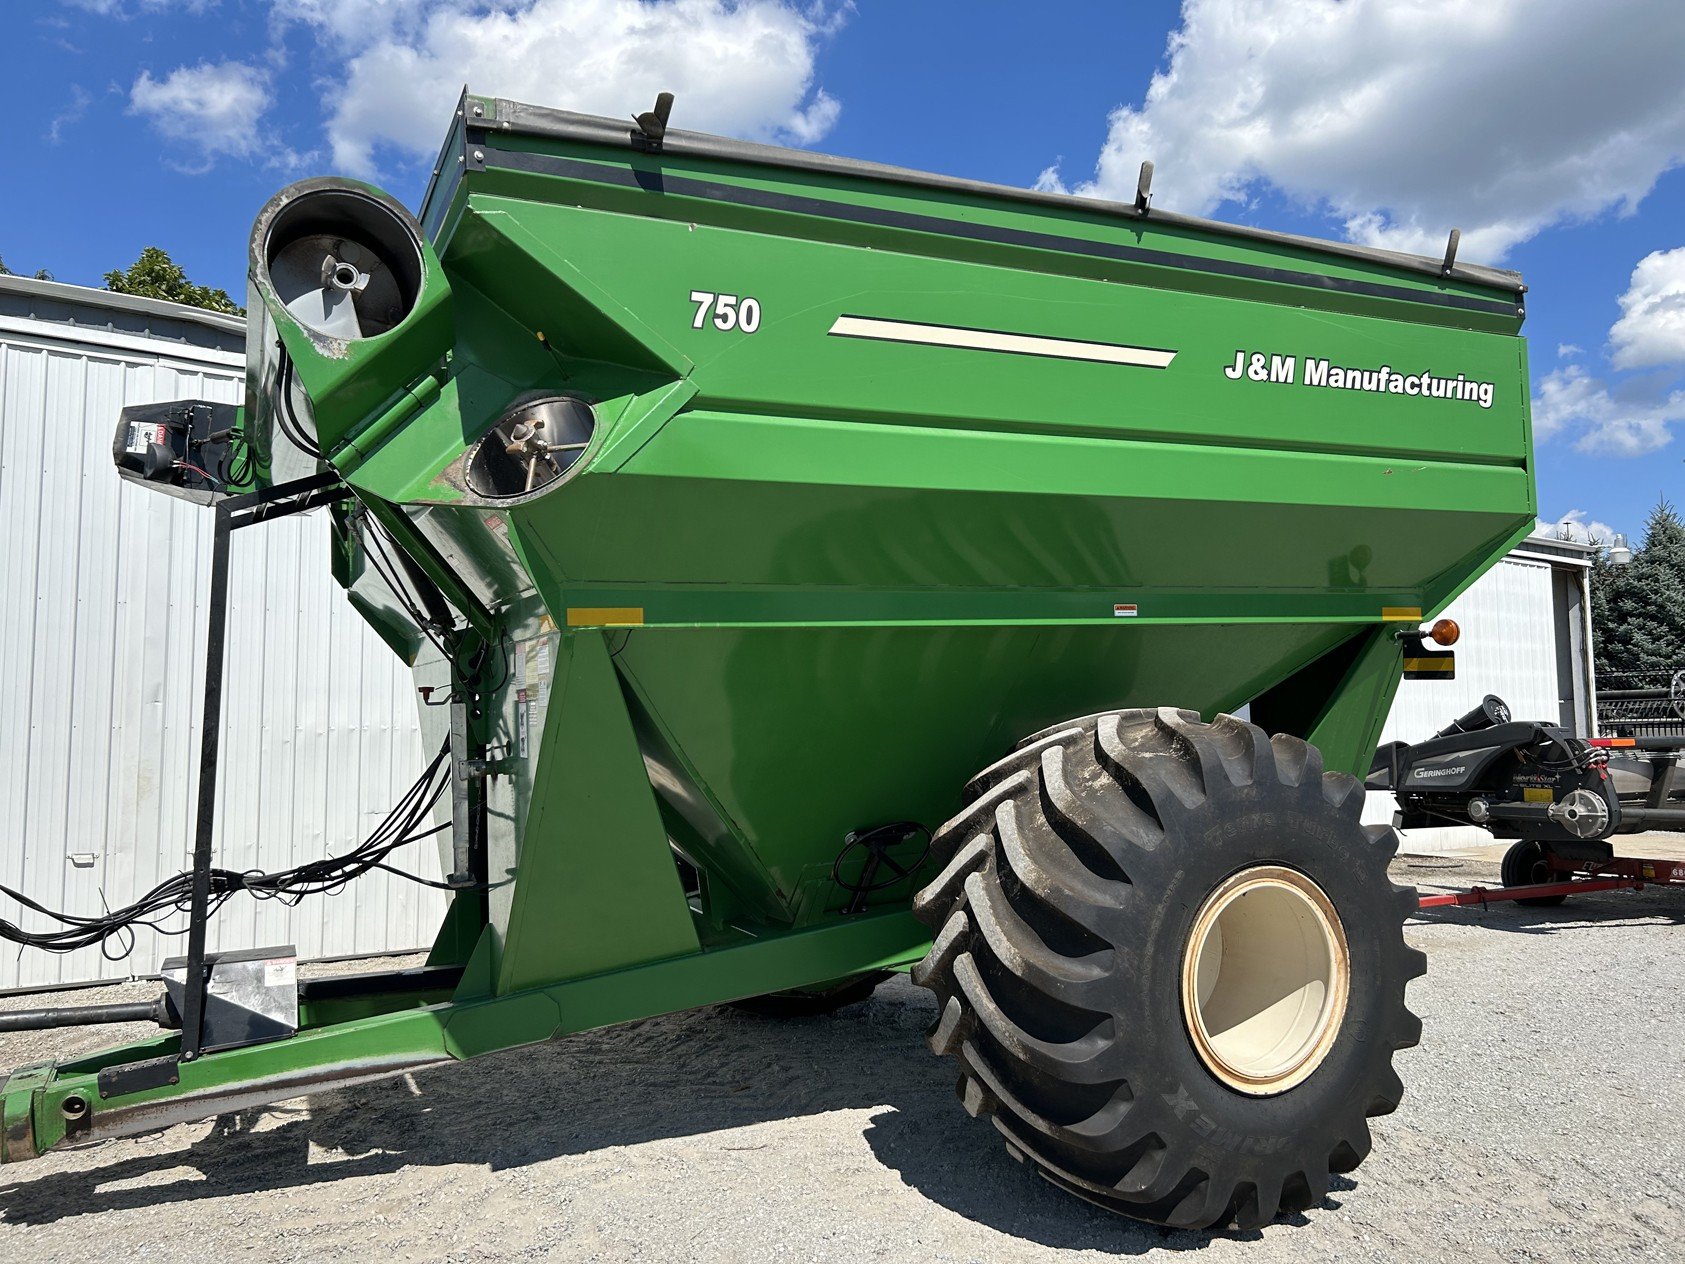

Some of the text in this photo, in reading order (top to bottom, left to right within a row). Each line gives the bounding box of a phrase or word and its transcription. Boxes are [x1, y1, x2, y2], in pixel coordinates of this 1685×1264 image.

[689, 289, 762, 334] 750
[1223, 350, 1495, 409] J&M Manufacturing
[1414, 766, 1466, 779] GERINGHOFF
[1672, 868, 1685, 877] 68
